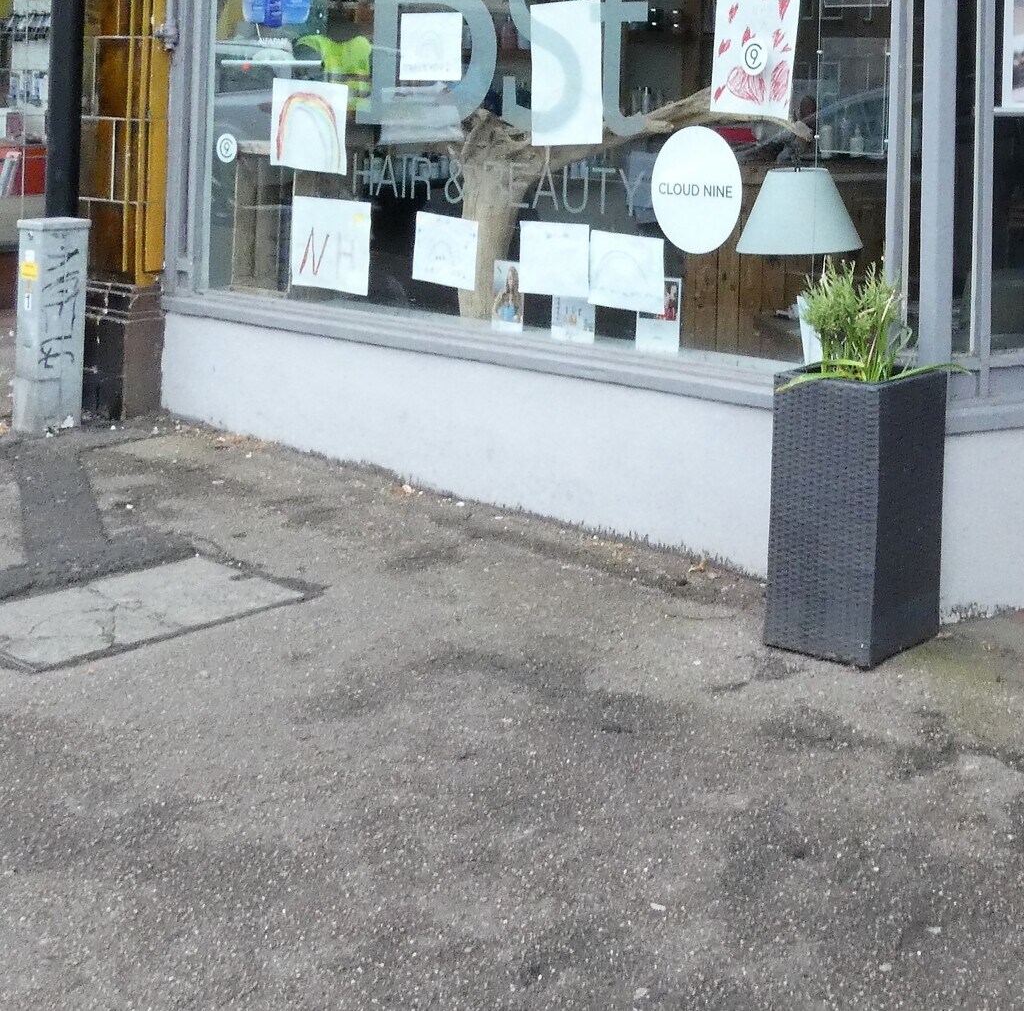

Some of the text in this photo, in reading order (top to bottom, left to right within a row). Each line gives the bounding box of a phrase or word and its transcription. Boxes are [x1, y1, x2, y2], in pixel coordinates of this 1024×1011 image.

[352, 152, 431, 200] HAIR
[444, 158, 464, 204] &
[658, 182, 733, 199] CLOUD NINE
